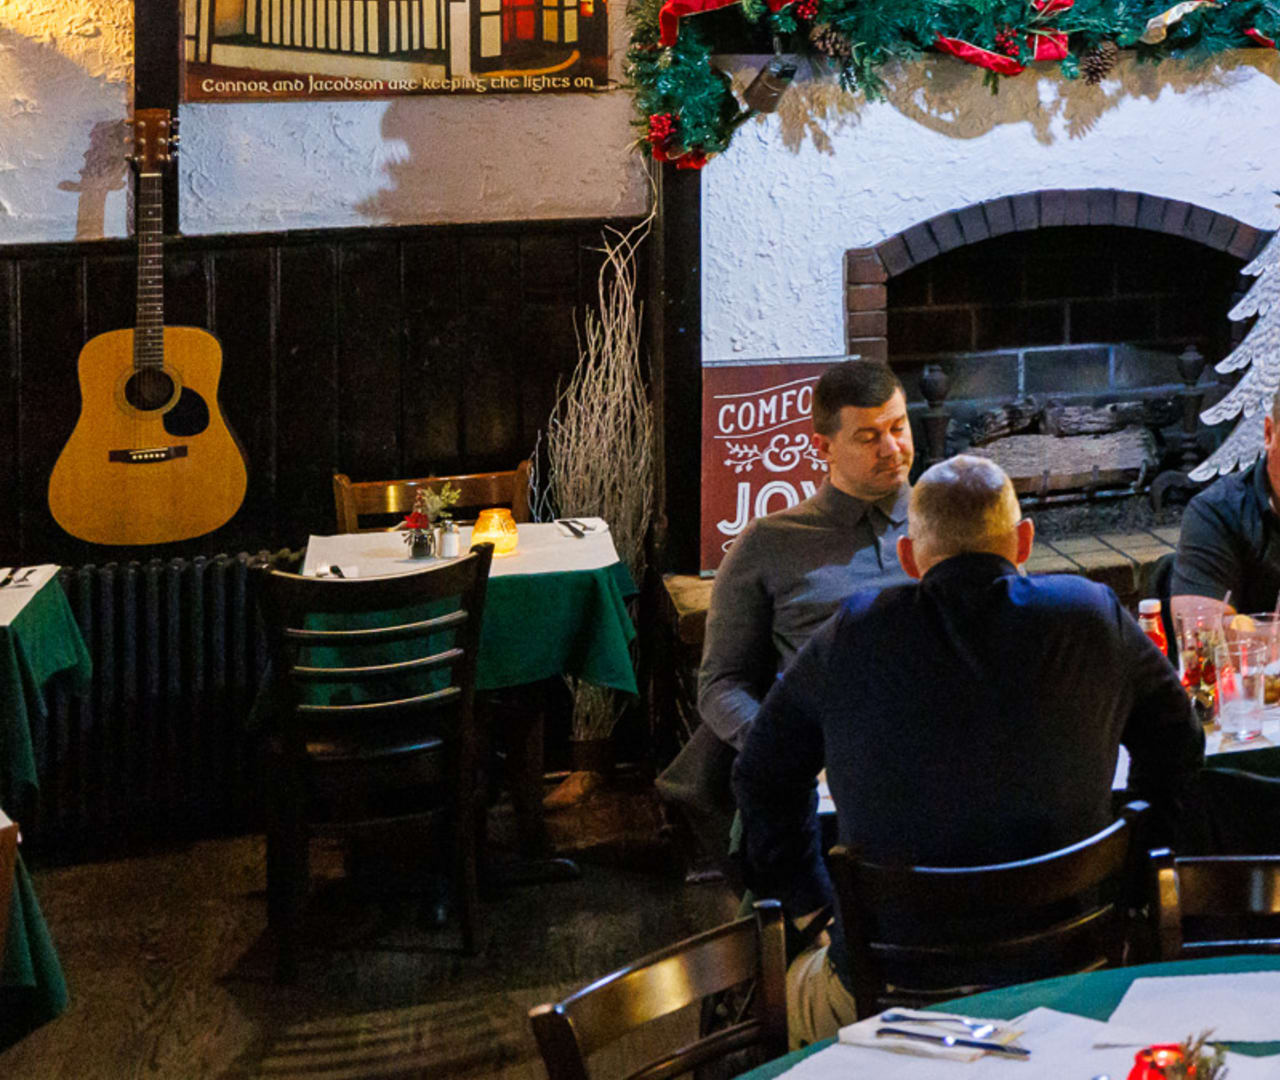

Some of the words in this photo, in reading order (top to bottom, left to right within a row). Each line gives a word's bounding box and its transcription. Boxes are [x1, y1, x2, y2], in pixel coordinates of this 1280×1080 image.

[201, 78, 271, 93] Connor
[272, 79, 304, 92] and
[308, 75, 384, 94] Jacobson
[387, 80, 418, 92] are
[422, 76, 488, 93] keeping
[490, 76, 521, 89] the
[523, 75, 571, 91] lights
[574, 76, 595, 88] on
[762, 433, 810, 472] &
